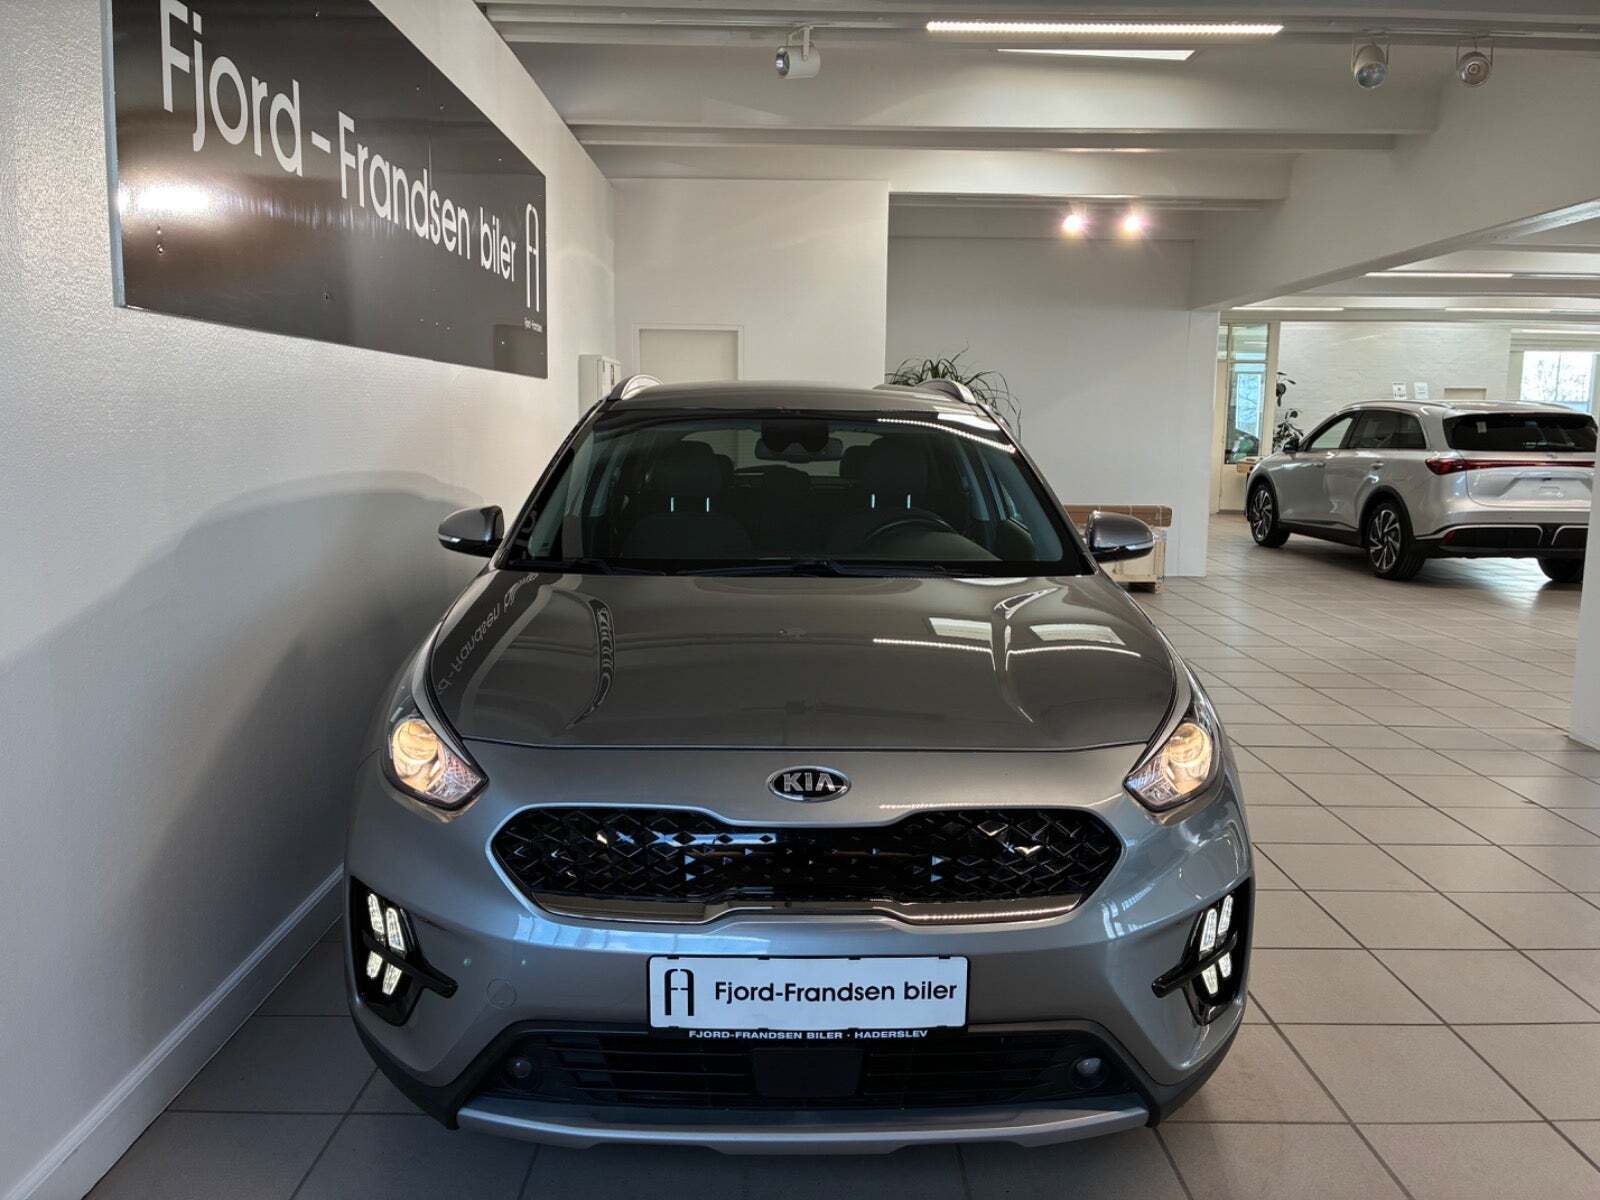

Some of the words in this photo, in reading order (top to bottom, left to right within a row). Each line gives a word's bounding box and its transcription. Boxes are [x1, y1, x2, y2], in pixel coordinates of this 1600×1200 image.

[160, 0, 470, 260] Fjord-Frandsen
[480, 207, 516, 282] biler
[783, 772, 836, 792] KIA
[715, 981, 895, 1004] Fjord-Frandsen
[903, 981, 958, 1000] biler
[689, 1030, 802, 1040] FJORD-FRANDSEN
[806, 1031, 843, 1040] BILER
[854, 1030, 928, 1039] HADERSLEV
